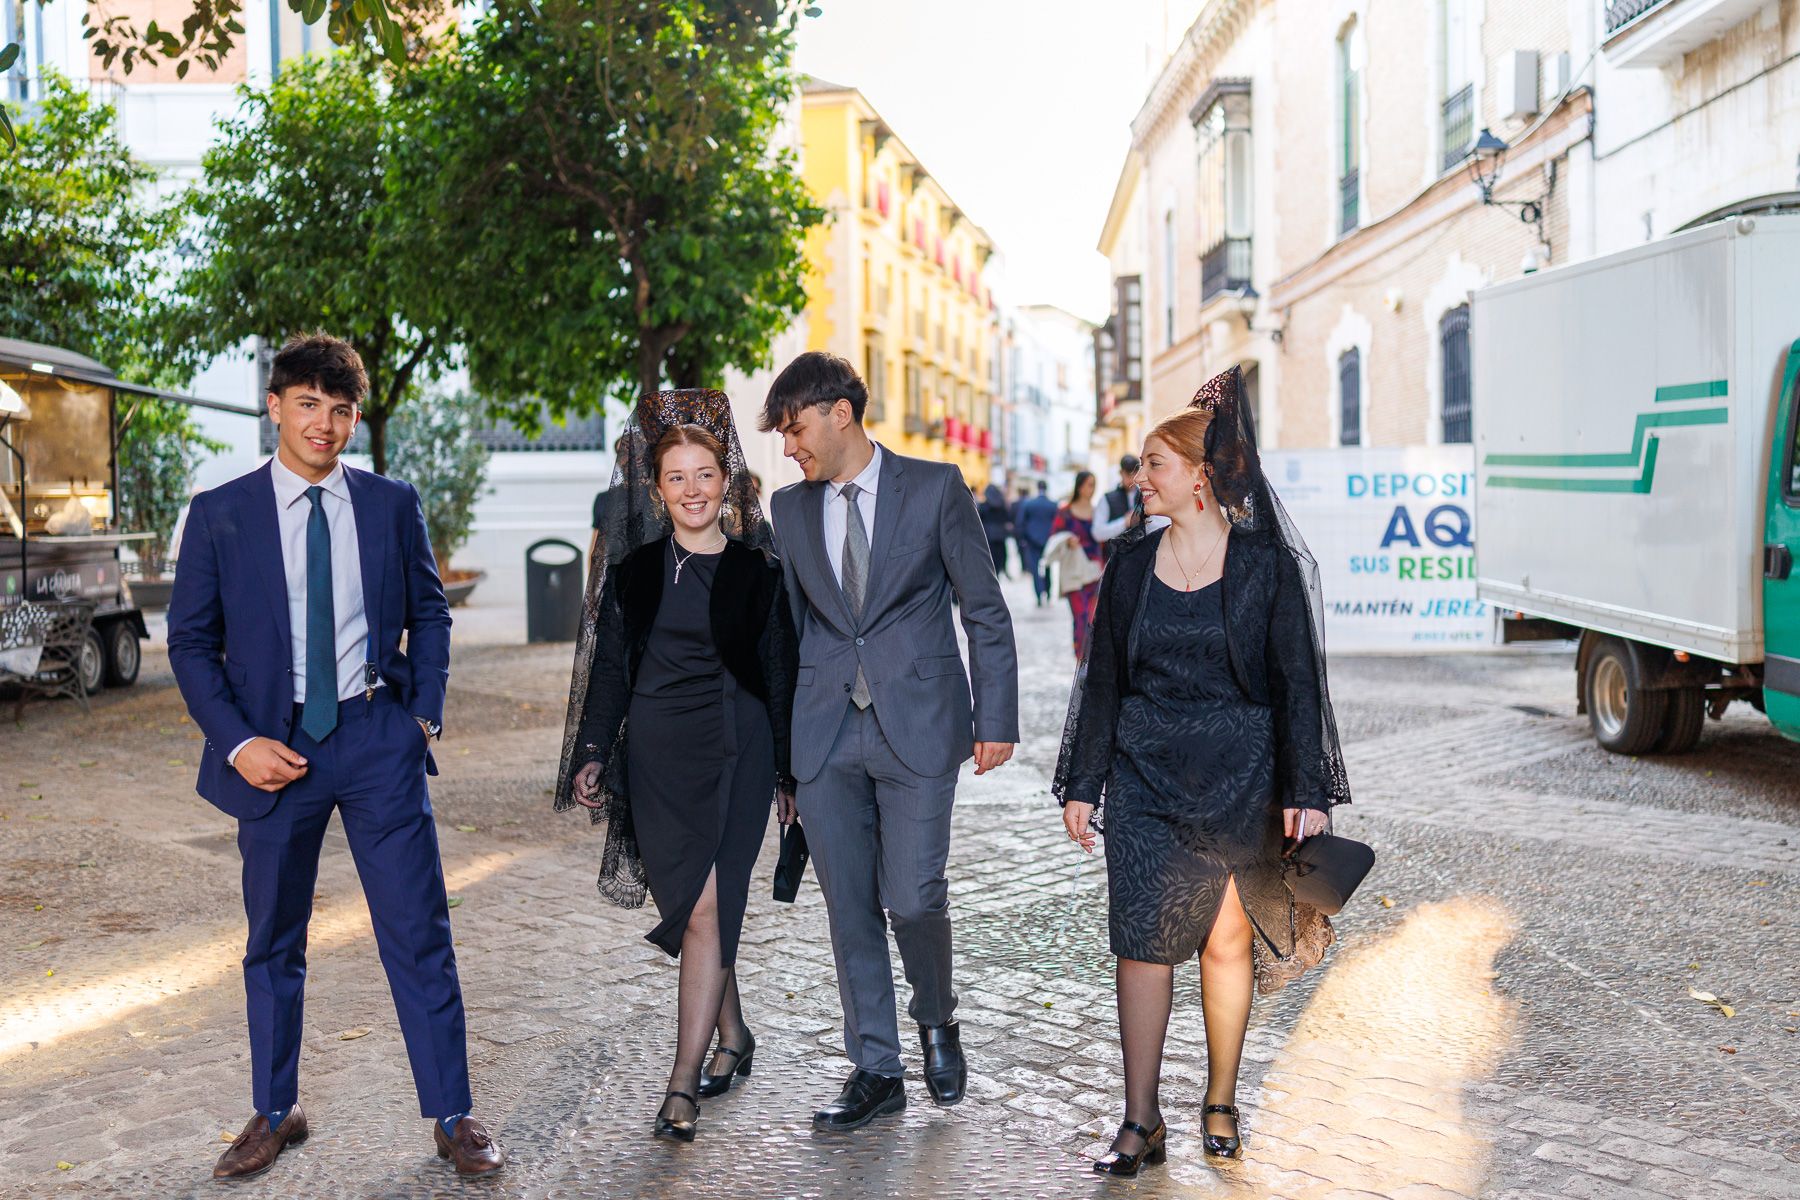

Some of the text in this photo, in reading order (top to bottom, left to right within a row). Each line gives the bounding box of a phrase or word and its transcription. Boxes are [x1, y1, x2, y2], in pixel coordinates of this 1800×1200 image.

[1347, 473, 1475, 497] DEPOSI
[1380, 503, 1475, 548] AQ
[1350, 556, 1389, 573] SUS
[1419, 599, 1487, 617] JEREZ
